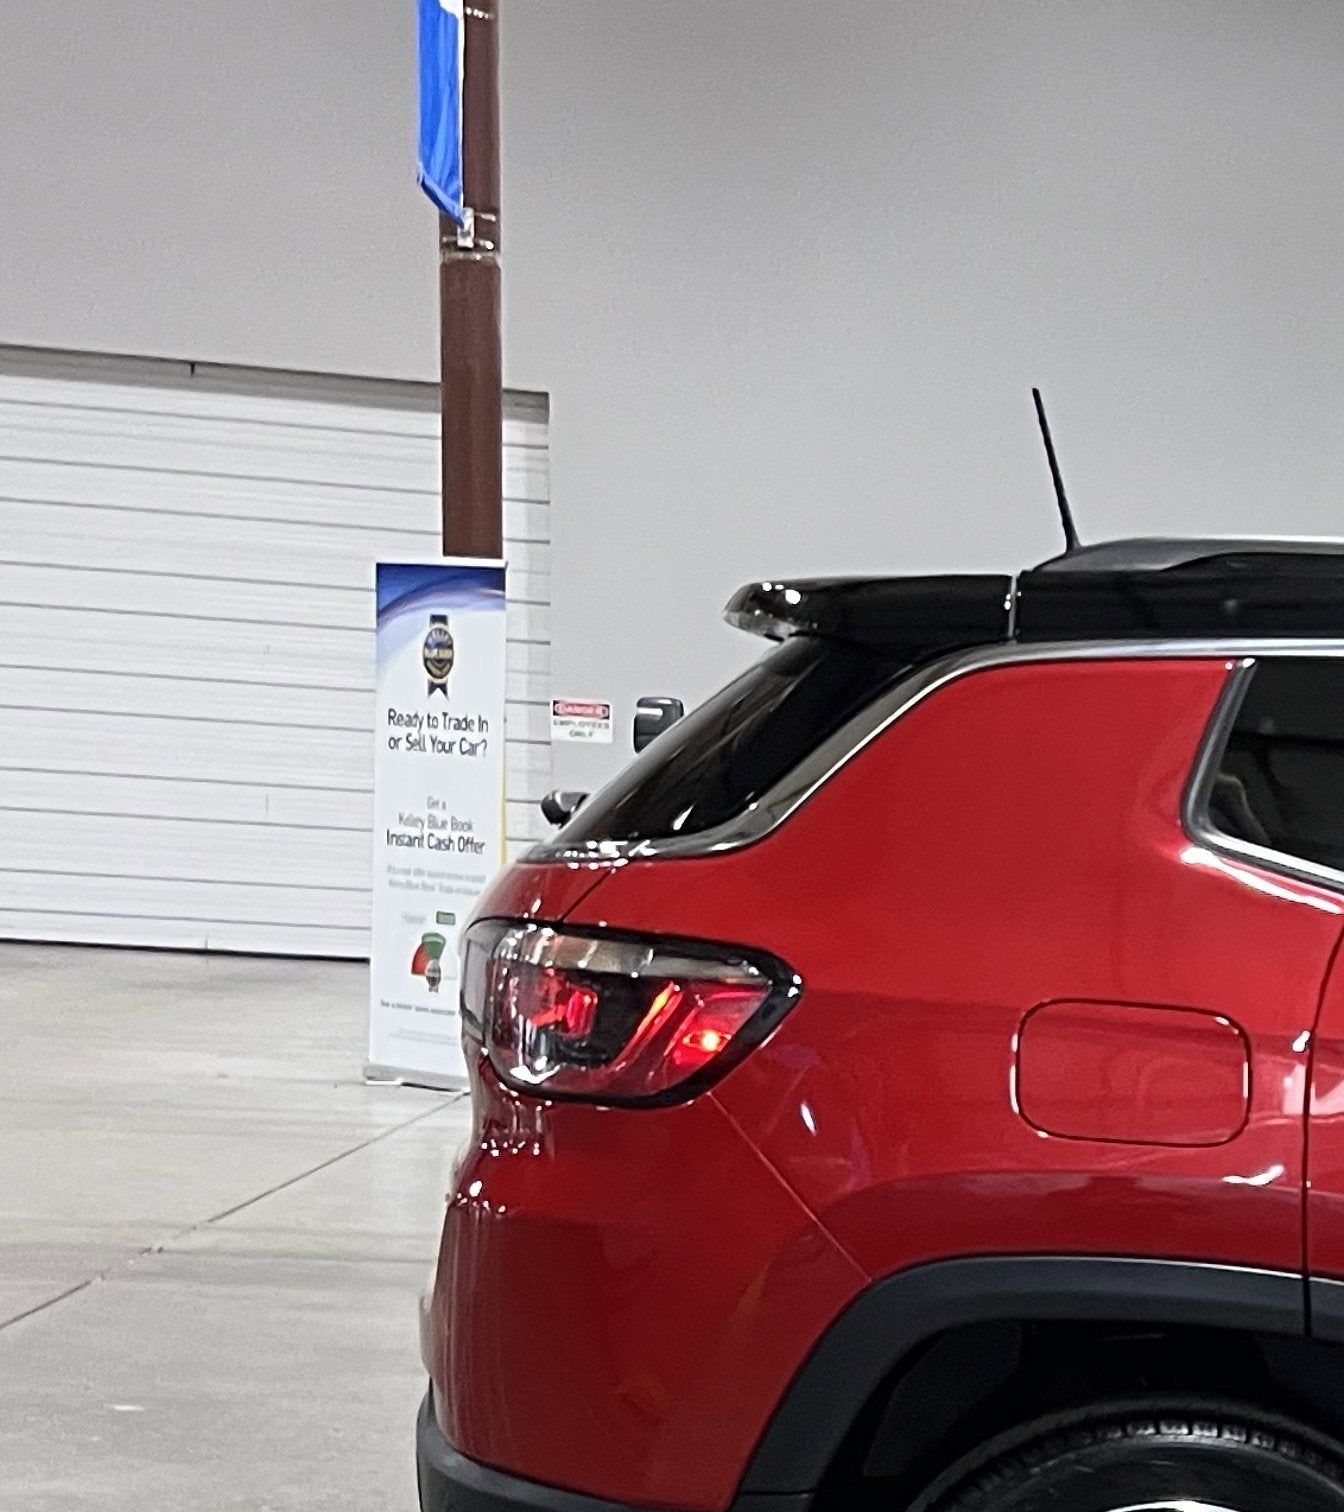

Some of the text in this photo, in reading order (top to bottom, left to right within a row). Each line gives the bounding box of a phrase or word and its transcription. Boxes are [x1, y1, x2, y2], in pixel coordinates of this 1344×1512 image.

[387, 707, 489, 733] Ready to Trade In
[388, 733, 488, 757] or Sell Your Car?
[427, 814, 448, 829] Blue
[450, 816, 474, 832] Book
[386, 829, 486, 855] Instant Cash Offer
